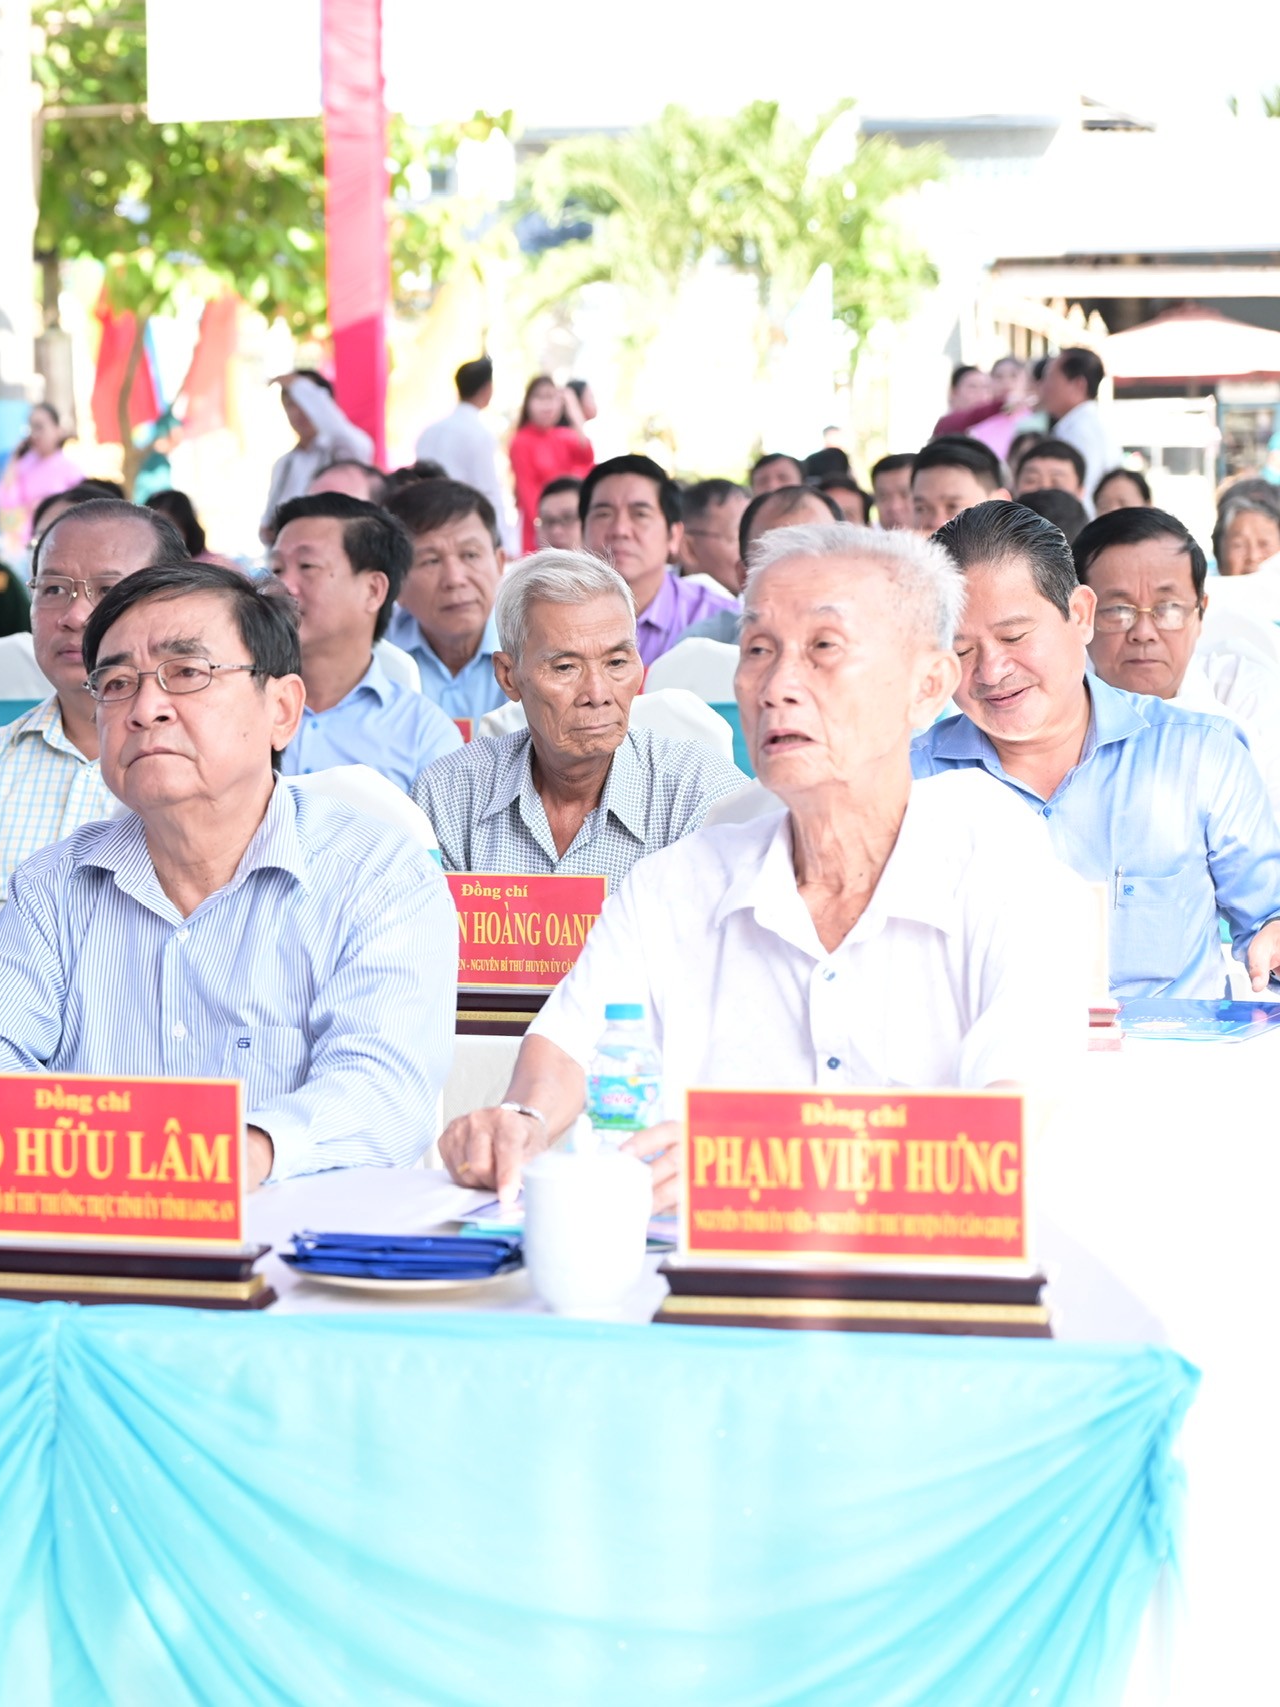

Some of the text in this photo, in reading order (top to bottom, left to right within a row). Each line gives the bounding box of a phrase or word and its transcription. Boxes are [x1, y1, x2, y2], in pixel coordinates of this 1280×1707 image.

[461, 881, 528, 899] Đồng chí
[473, 902, 541, 946] HOÀNG
[35, 1084, 131, 1115] Đồng chí
[801, 1098, 866, 1129] Đồng
[15, 1117, 116, 1180] HỮU
[126, 1117, 232, 1183] LÂM
[693, 1130, 1019, 1206] PHẠM VIỆT HƯNG
